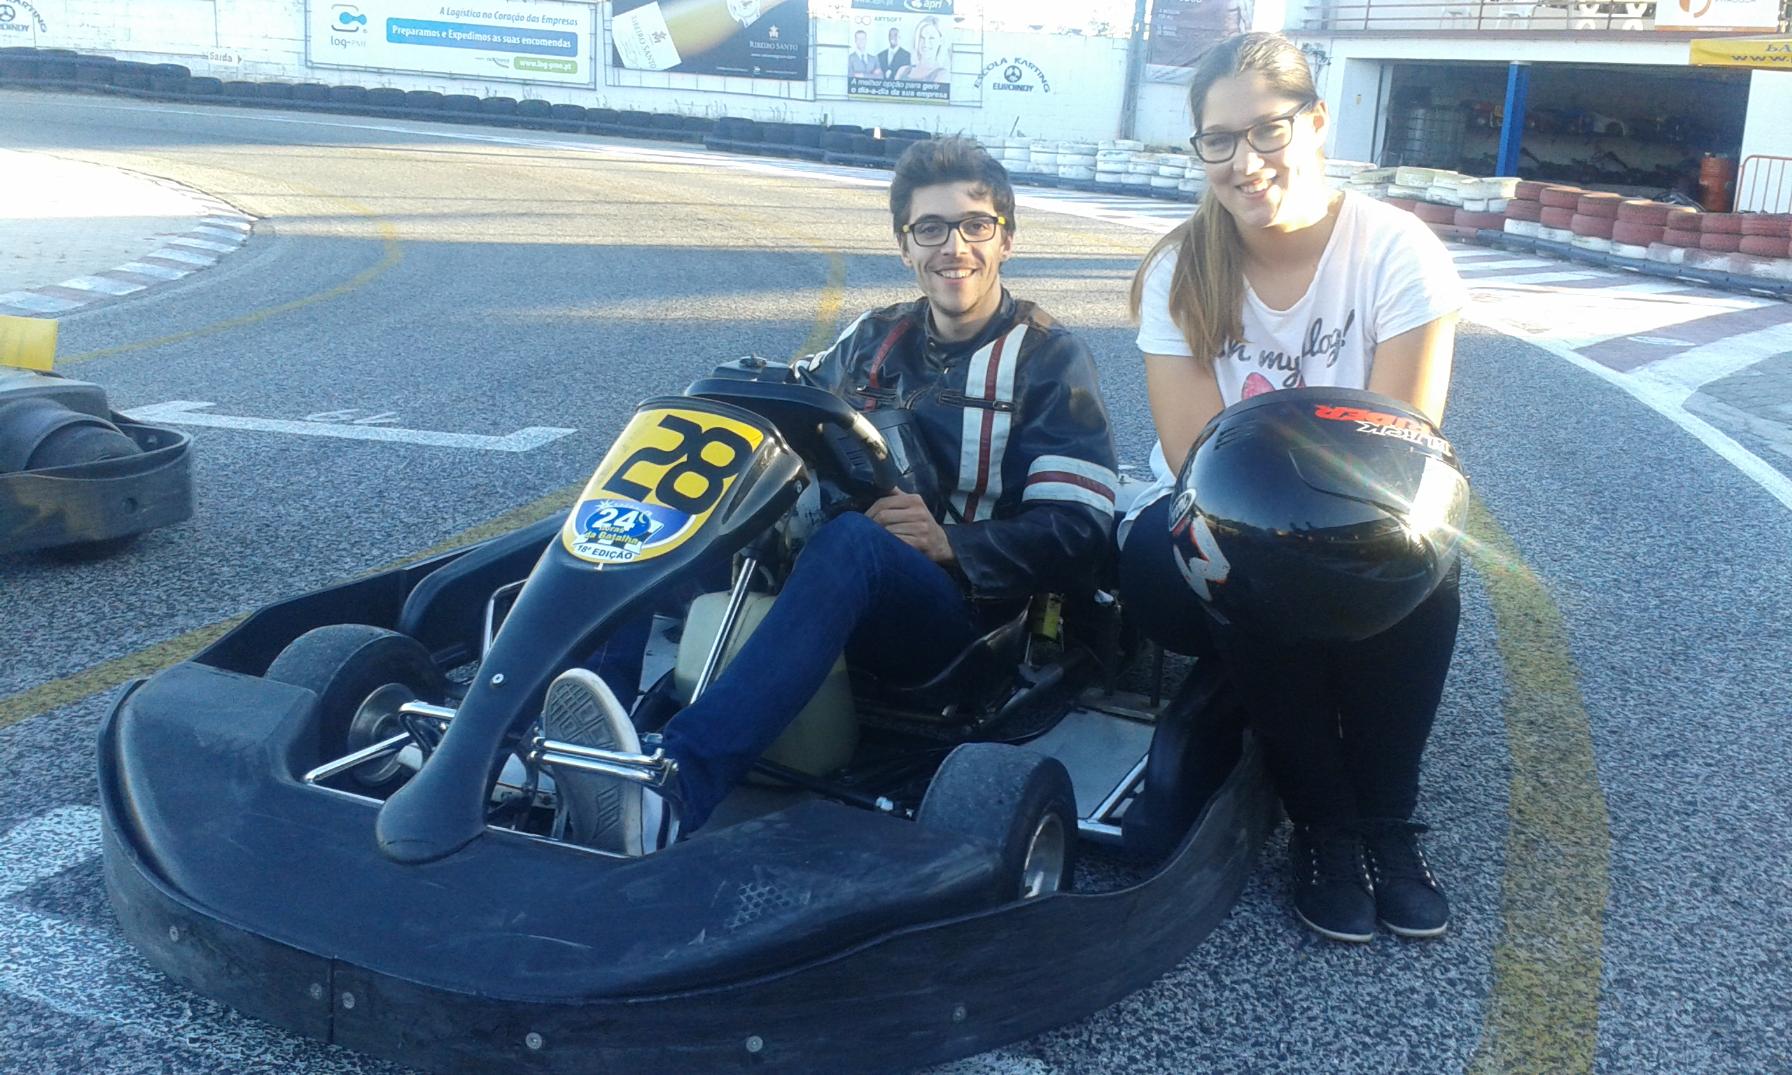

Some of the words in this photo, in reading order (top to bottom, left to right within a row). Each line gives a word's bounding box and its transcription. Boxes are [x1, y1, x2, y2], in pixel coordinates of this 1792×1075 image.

[526, 14, 540, 23] das
[541, 15, 578, 27] Empresas
[392, 25, 441, 38] Preparamos
[448, 29, 491, 42] Expedimos
[492, 35, 502, 43] as
[503, 36, 520, 45] suas
[521, 36, 571, 49] encomendas
[776, 42, 799, 52] SANTO
[1014, 57, 1051, 93] KARTING
[858, 78, 882, 86] melhor
[882, 80, 905, 90] opção
[905, 82, 921, 90] para
[922, 82, 940, 91] gerir
[857, 86, 889, 95] dia-a-dia
[916, 90, 948, 99] empresa
[1258, 349, 1302, 388] my
[601, 414, 754, 516] 28
[591, 507, 640, 531] 24
[598, 532, 639, 545] Batalha
[592, 548, 633, 560] EDIÇÃO
